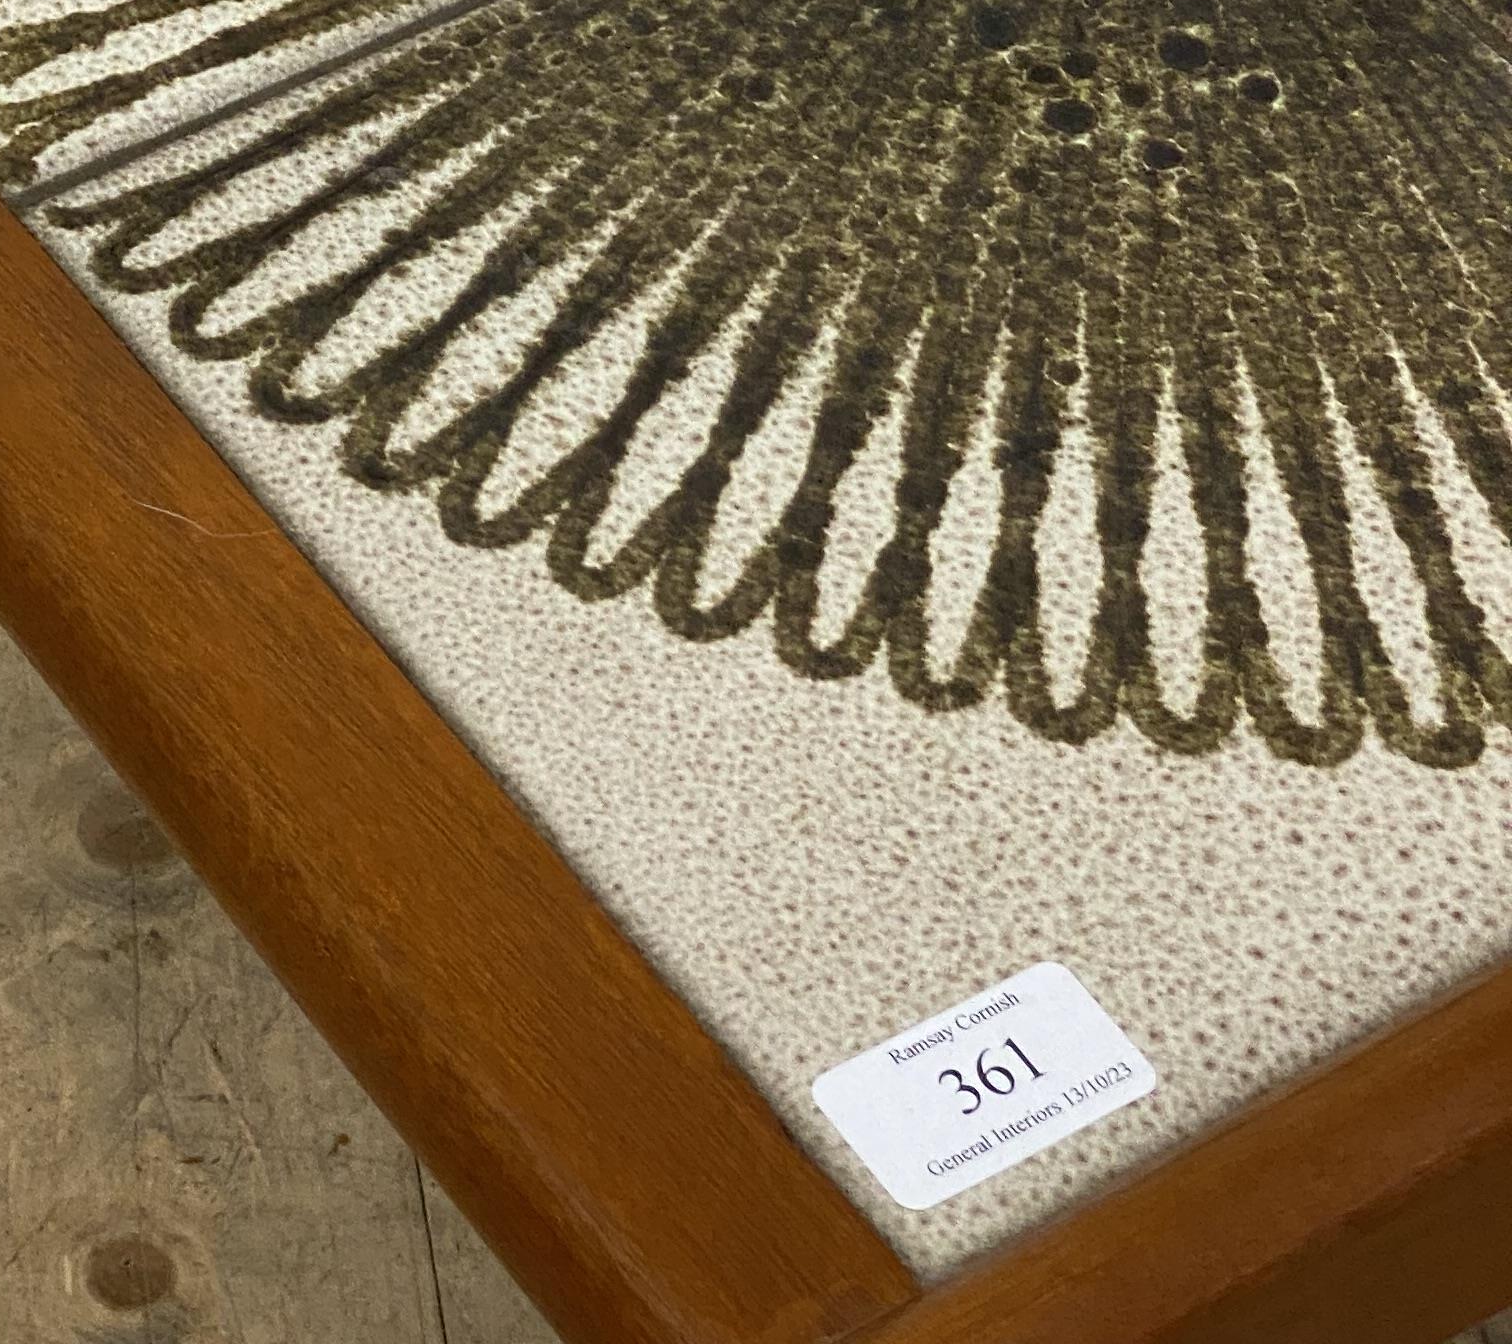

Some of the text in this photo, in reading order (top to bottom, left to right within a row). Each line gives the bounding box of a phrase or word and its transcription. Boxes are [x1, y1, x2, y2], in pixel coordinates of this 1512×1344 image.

[888, 991, 1022, 1065] Ramsay Cornish
[938, 1037, 1047, 1115] 361
[926, 1061, 1133, 1177] General Interiors 13/10/23
